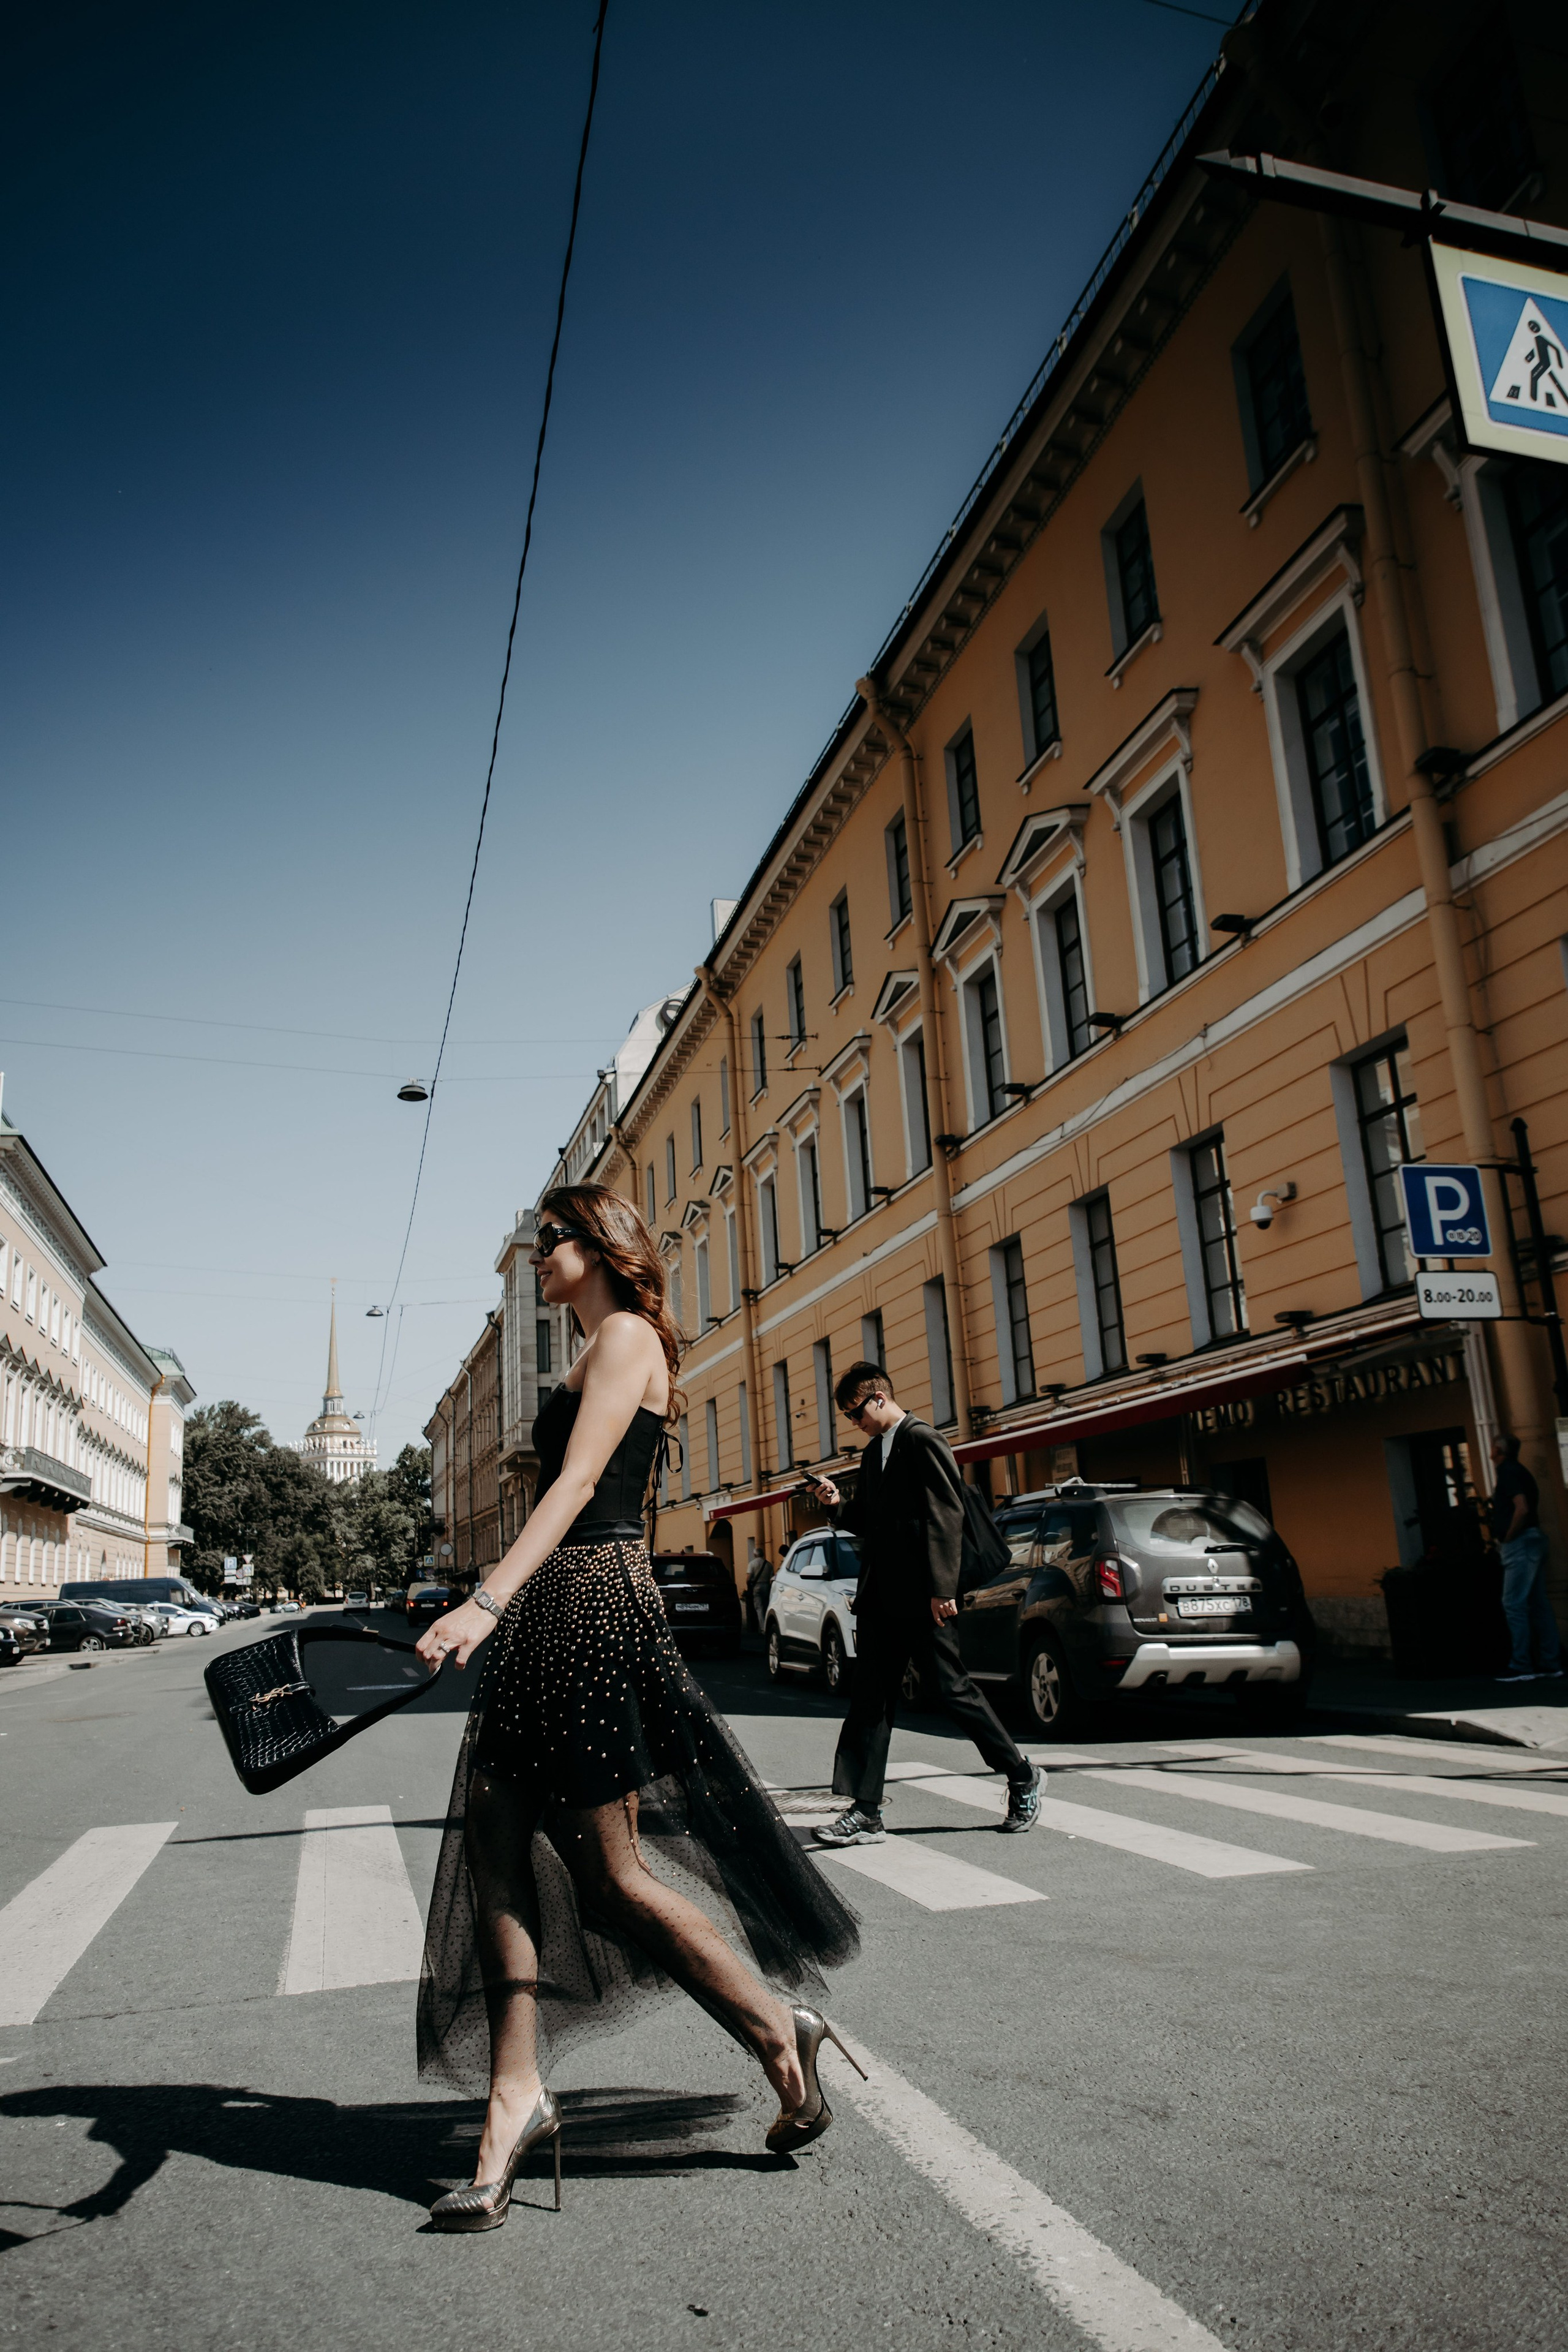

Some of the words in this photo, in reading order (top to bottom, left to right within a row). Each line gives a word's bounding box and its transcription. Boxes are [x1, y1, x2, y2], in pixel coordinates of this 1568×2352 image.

[1424, 1175, 1470, 1246] P
[1467, 1231, 1482, 1242] 20
[1423, 1288, 1493, 1303] 8.00-20.00
[1274, 1350, 1465, 1415] RESTAURANT
[1170, 1583, 1261, 1592] DUSTER
